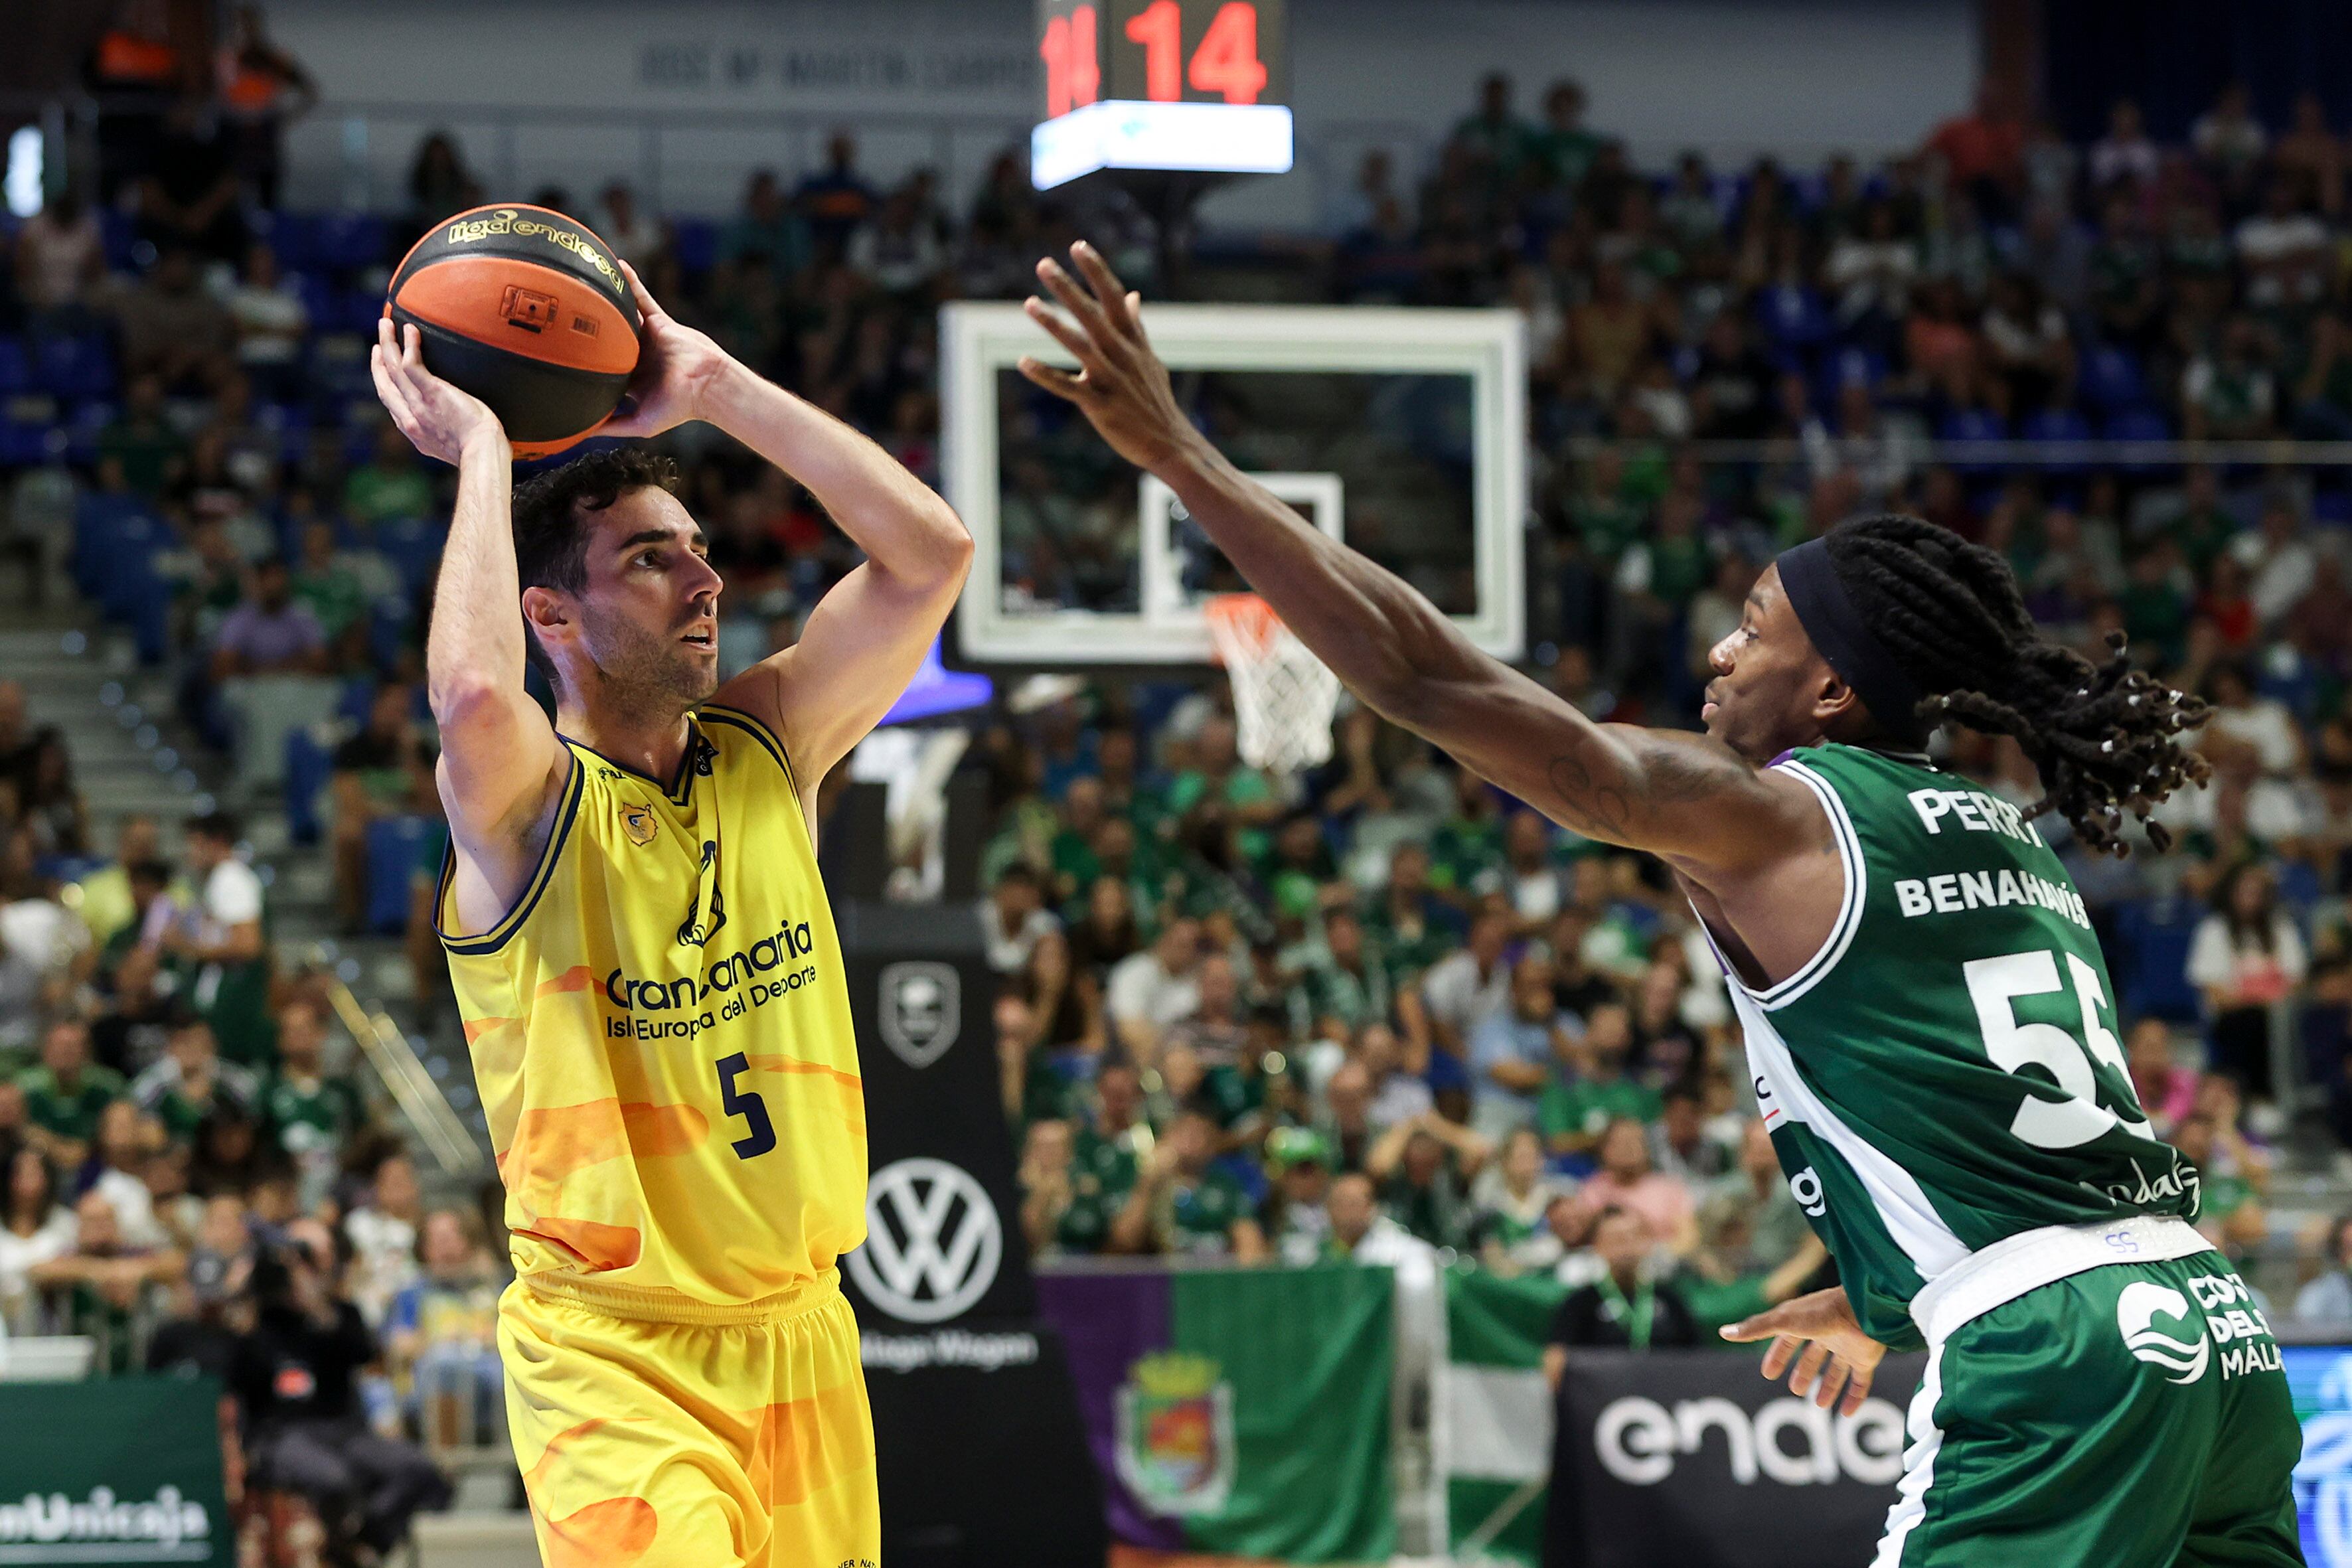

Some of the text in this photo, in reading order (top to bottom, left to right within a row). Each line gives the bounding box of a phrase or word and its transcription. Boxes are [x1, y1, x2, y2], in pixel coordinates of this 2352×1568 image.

[1125, 0, 1268, 105] 14
[448, 216, 625, 294] liga endesa
[607, 964, 817, 1041] Isl Europa del Deporte
[1962, 949, 2157, 1150] 55
[716, 1052, 777, 1160] 5
[2206, 1310, 2264, 1338] DEL
